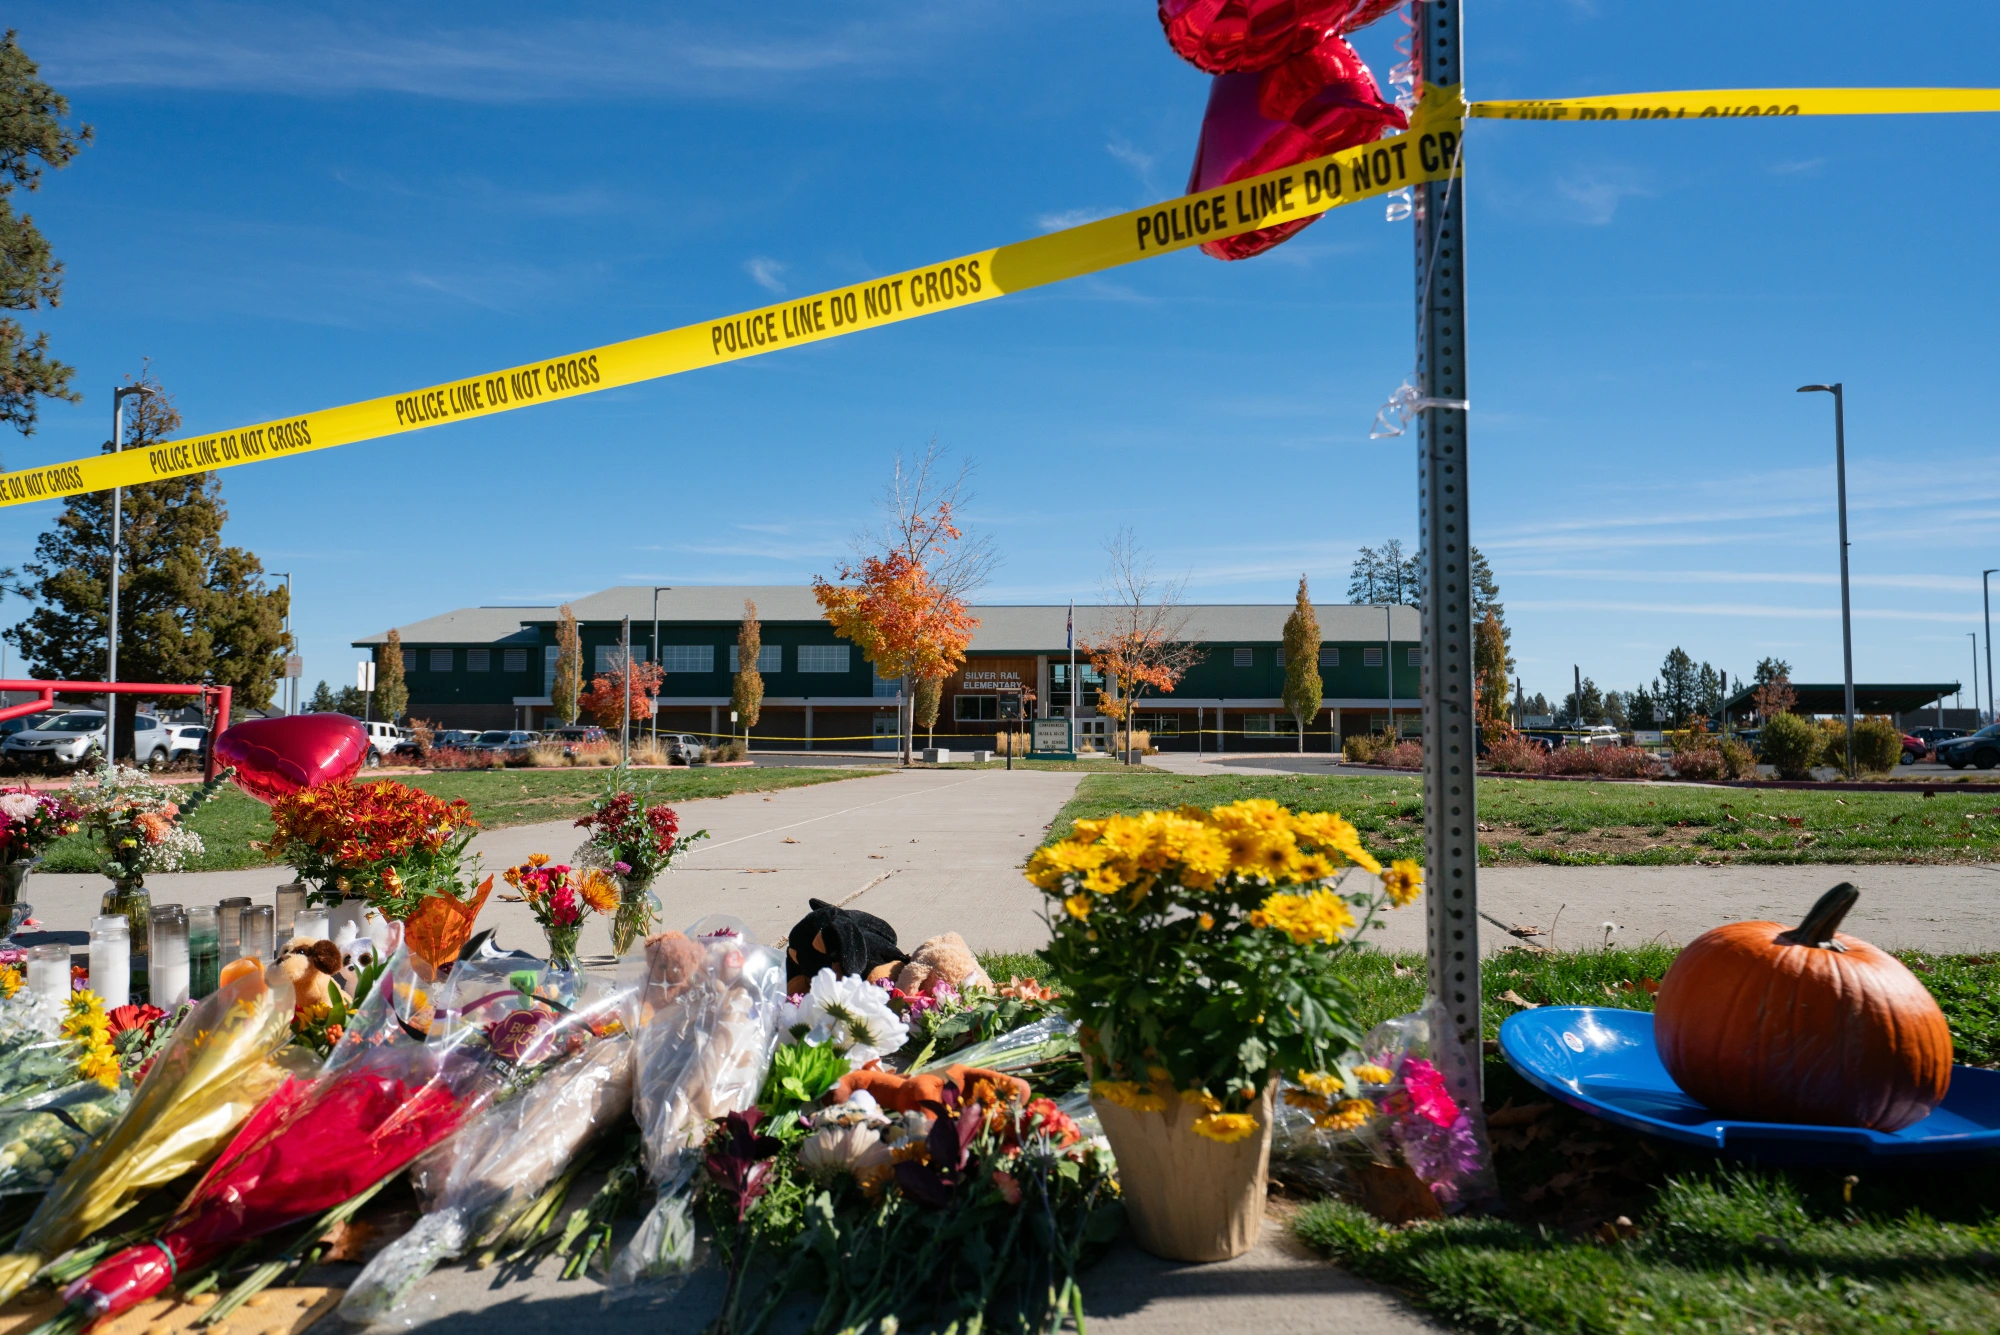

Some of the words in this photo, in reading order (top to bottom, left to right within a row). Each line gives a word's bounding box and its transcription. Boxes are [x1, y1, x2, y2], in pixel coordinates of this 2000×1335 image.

[1137, 195, 1229, 250] POLICE
[1236, 176, 1295, 223] LINE
[1304, 163, 1341, 205] DO
[1352, 142, 1408, 192] NOT
[711, 312, 778, 355] POLICE
[782, 300, 826, 339] LINE
[830, 292, 858, 327] DO
[864, 280, 903, 320] NOT
[910, 260, 982, 307] CROSS
[395, 390, 448, 425] POLICE
[449, 382, 484, 414] LINE
[486, 376, 509, 406] DO
[510, 368, 543, 401] NOT
[545, 354, 600, 393] CROSS
[150, 448, 193, 474] POLICE
[192, 443, 222, 467] LINE
[222, 435, 240, 460] DO
[240, 429, 266, 456] NOT
[267, 419, 312, 450] CROSS
[8, 476, 26, 499] DO
[24, 472, 47, 496] NOT
[47, 465, 83, 493] CROSS
[963, 681, 1022, 689] ELEMENTARY
